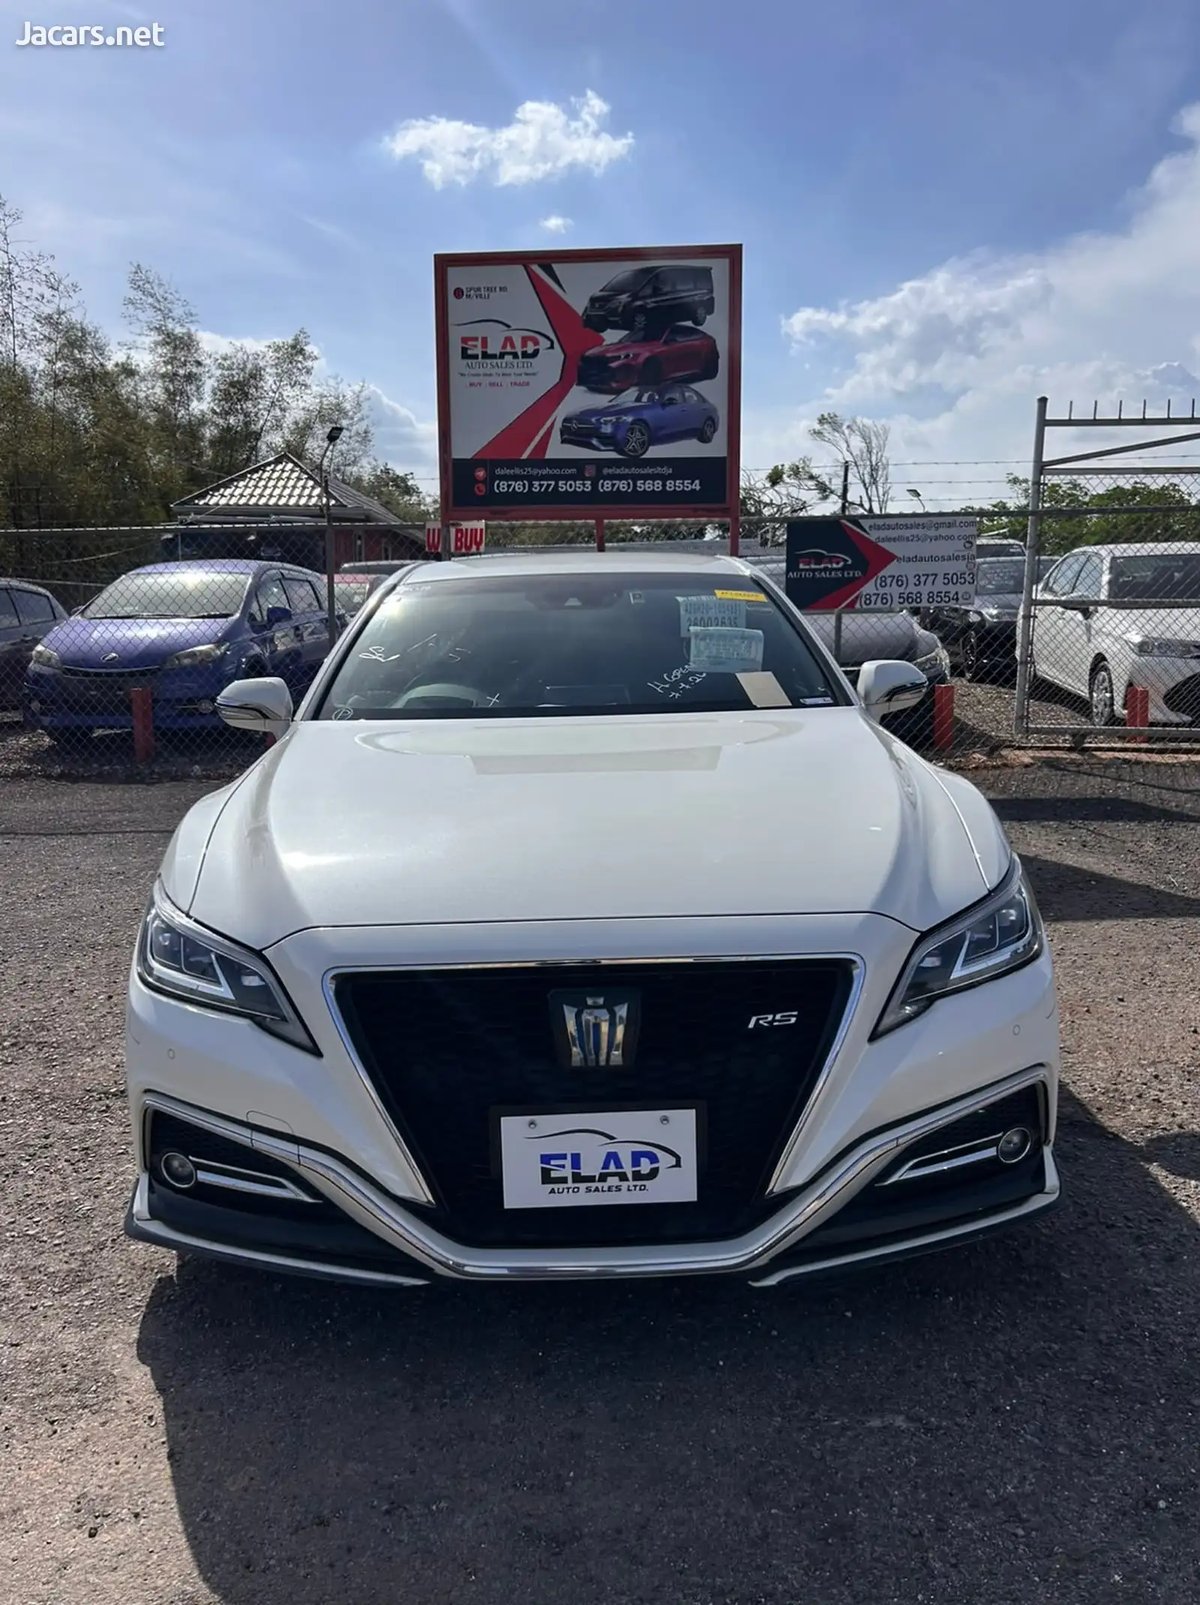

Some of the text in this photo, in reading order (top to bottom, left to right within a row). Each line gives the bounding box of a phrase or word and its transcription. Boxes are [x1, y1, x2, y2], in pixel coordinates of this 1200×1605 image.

[461, 335, 540, 360] ELAD
[465, 361, 489, 370] AUTO
[489, 361, 515, 369] SALES
[493, 479, 701, 493] (876) 377 5053 (876) 568 8554
[868, 519, 977, 532] eladautosales@gmail.com
[454, 528, 484, 553] BUY
[798, 558, 845, 569] ELAD
[874, 572, 976, 590] (876) 377 5053
[859, 591, 960, 608] (876) 568 8554
[747, 1011, 799, 1029] RS
[539, 1150, 660, 1185] ELAD
[548, 1184, 649, 1195] AUTO SALES LTD.
